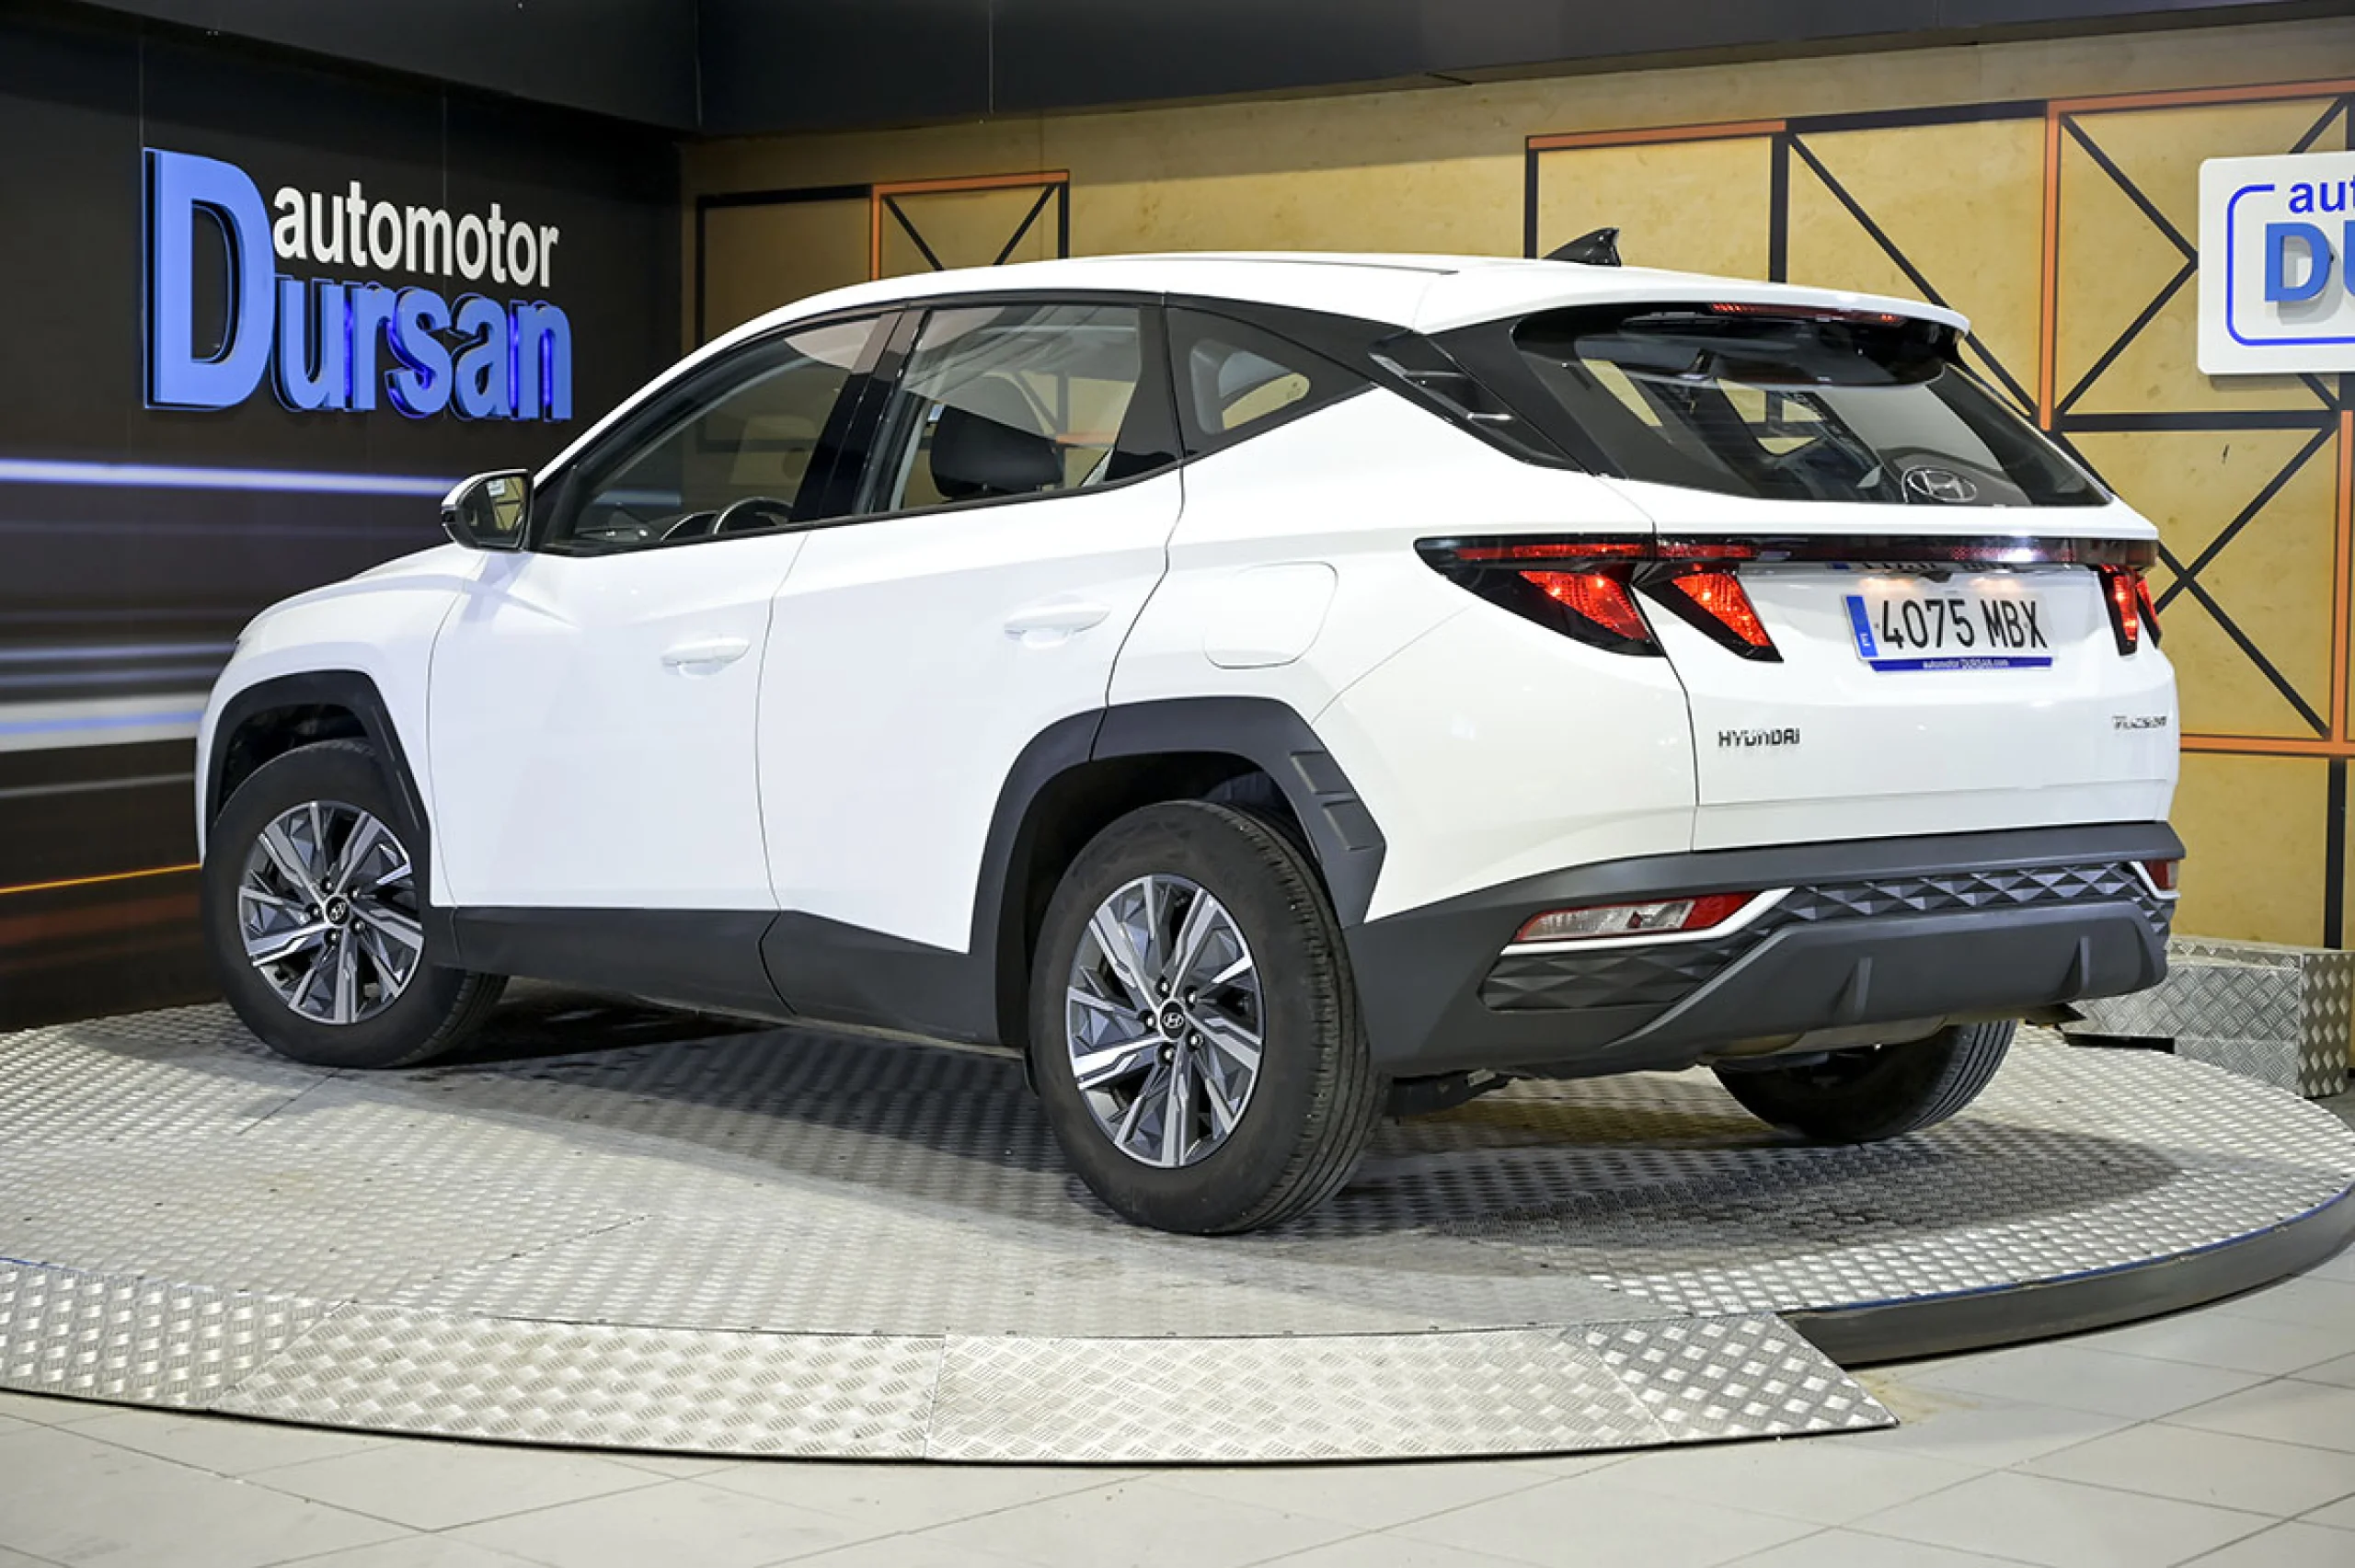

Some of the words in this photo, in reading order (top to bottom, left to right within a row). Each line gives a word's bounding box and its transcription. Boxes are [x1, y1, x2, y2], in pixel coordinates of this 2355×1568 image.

[273, 180, 559, 287] automotor
[2264, 219, 2355, 303] D
[143, 146, 572, 422] Dursan
[1882, 599, 1976, 649] 4075
[1980, 599, 2049, 649] MBX
[1717, 727, 1801, 748] HYUNDAI
